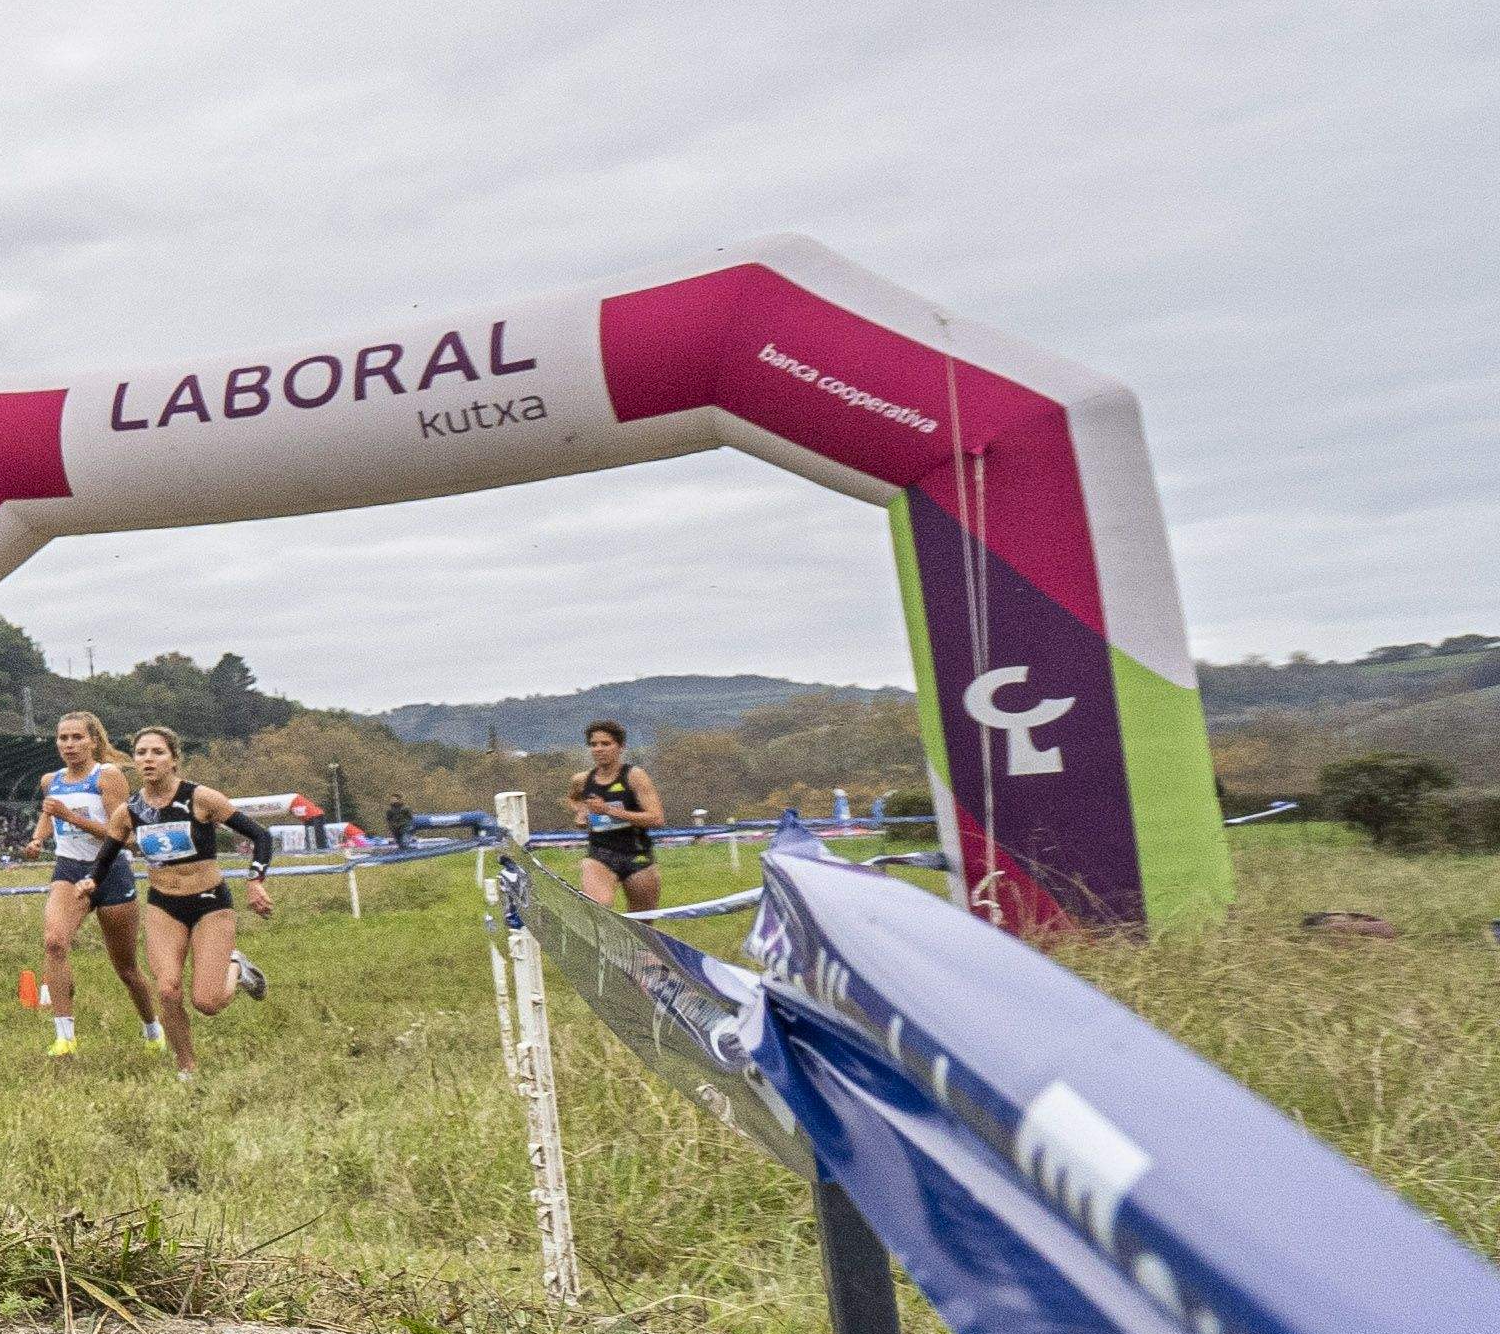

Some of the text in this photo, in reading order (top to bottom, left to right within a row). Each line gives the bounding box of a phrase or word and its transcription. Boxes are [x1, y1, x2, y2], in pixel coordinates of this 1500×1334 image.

[110, 320, 538, 433] LABORAL
[757, 342, 938, 434] banca cooperativa
[417, 394, 549, 440] kutxa
[158, 835, 173, 854] 3
